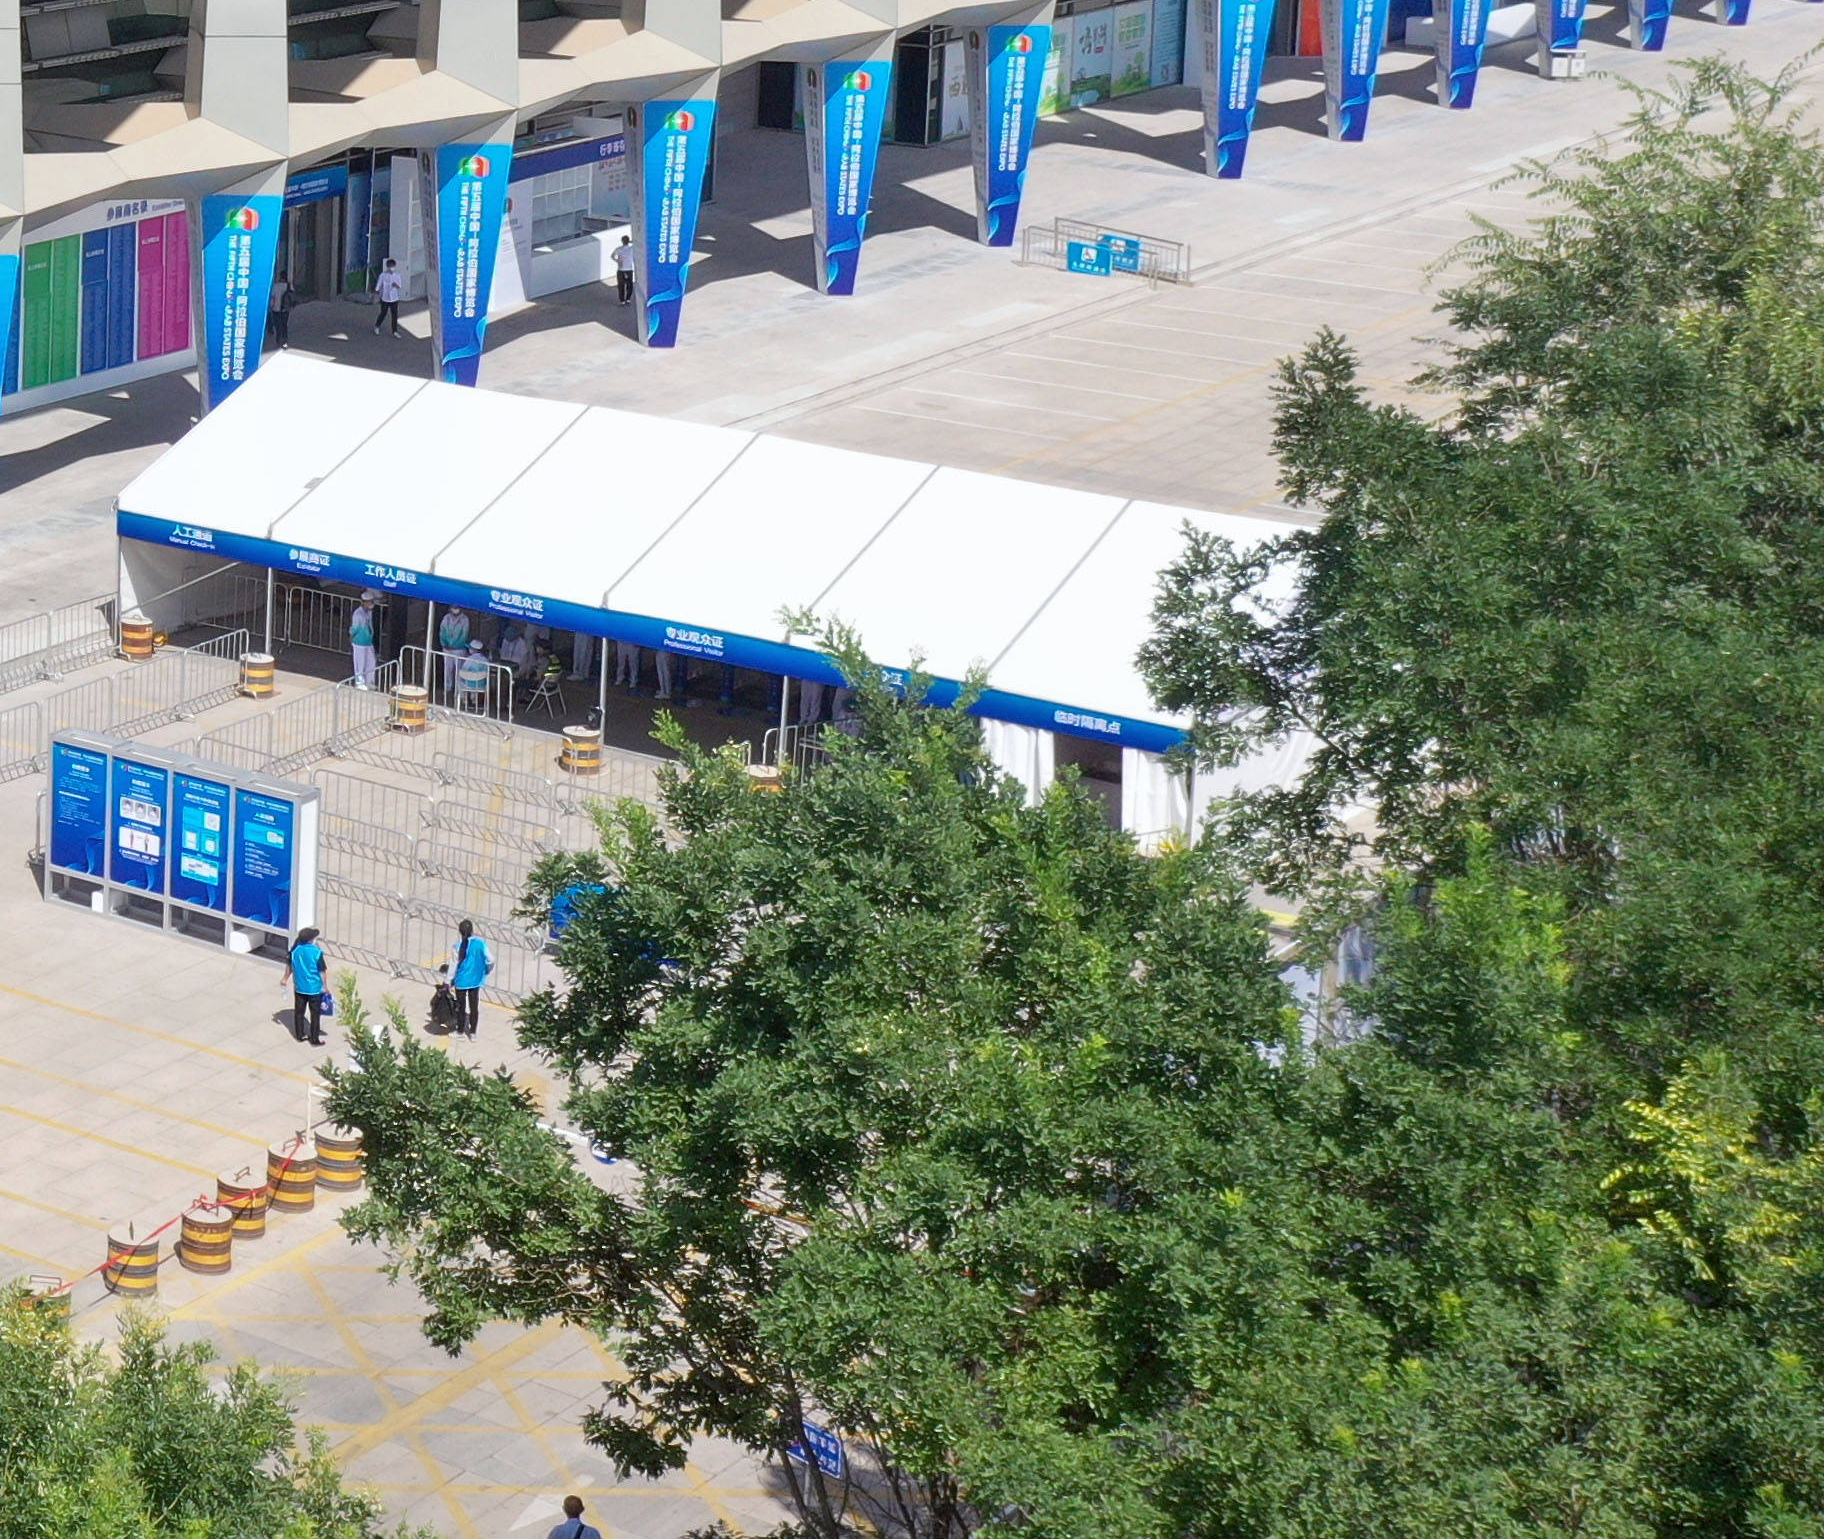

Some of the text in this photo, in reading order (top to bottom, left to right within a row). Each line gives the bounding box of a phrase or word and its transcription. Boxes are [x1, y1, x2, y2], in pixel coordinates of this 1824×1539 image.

[172, 524, 212, 542] 人工通道
[365, 563, 417, 585] 工作人员证
[490, 589, 544, 612] 专业观众证
[665, 626, 724, 649] 专业观众证
[1054, 709, 1121, 735] 临时隔离点
